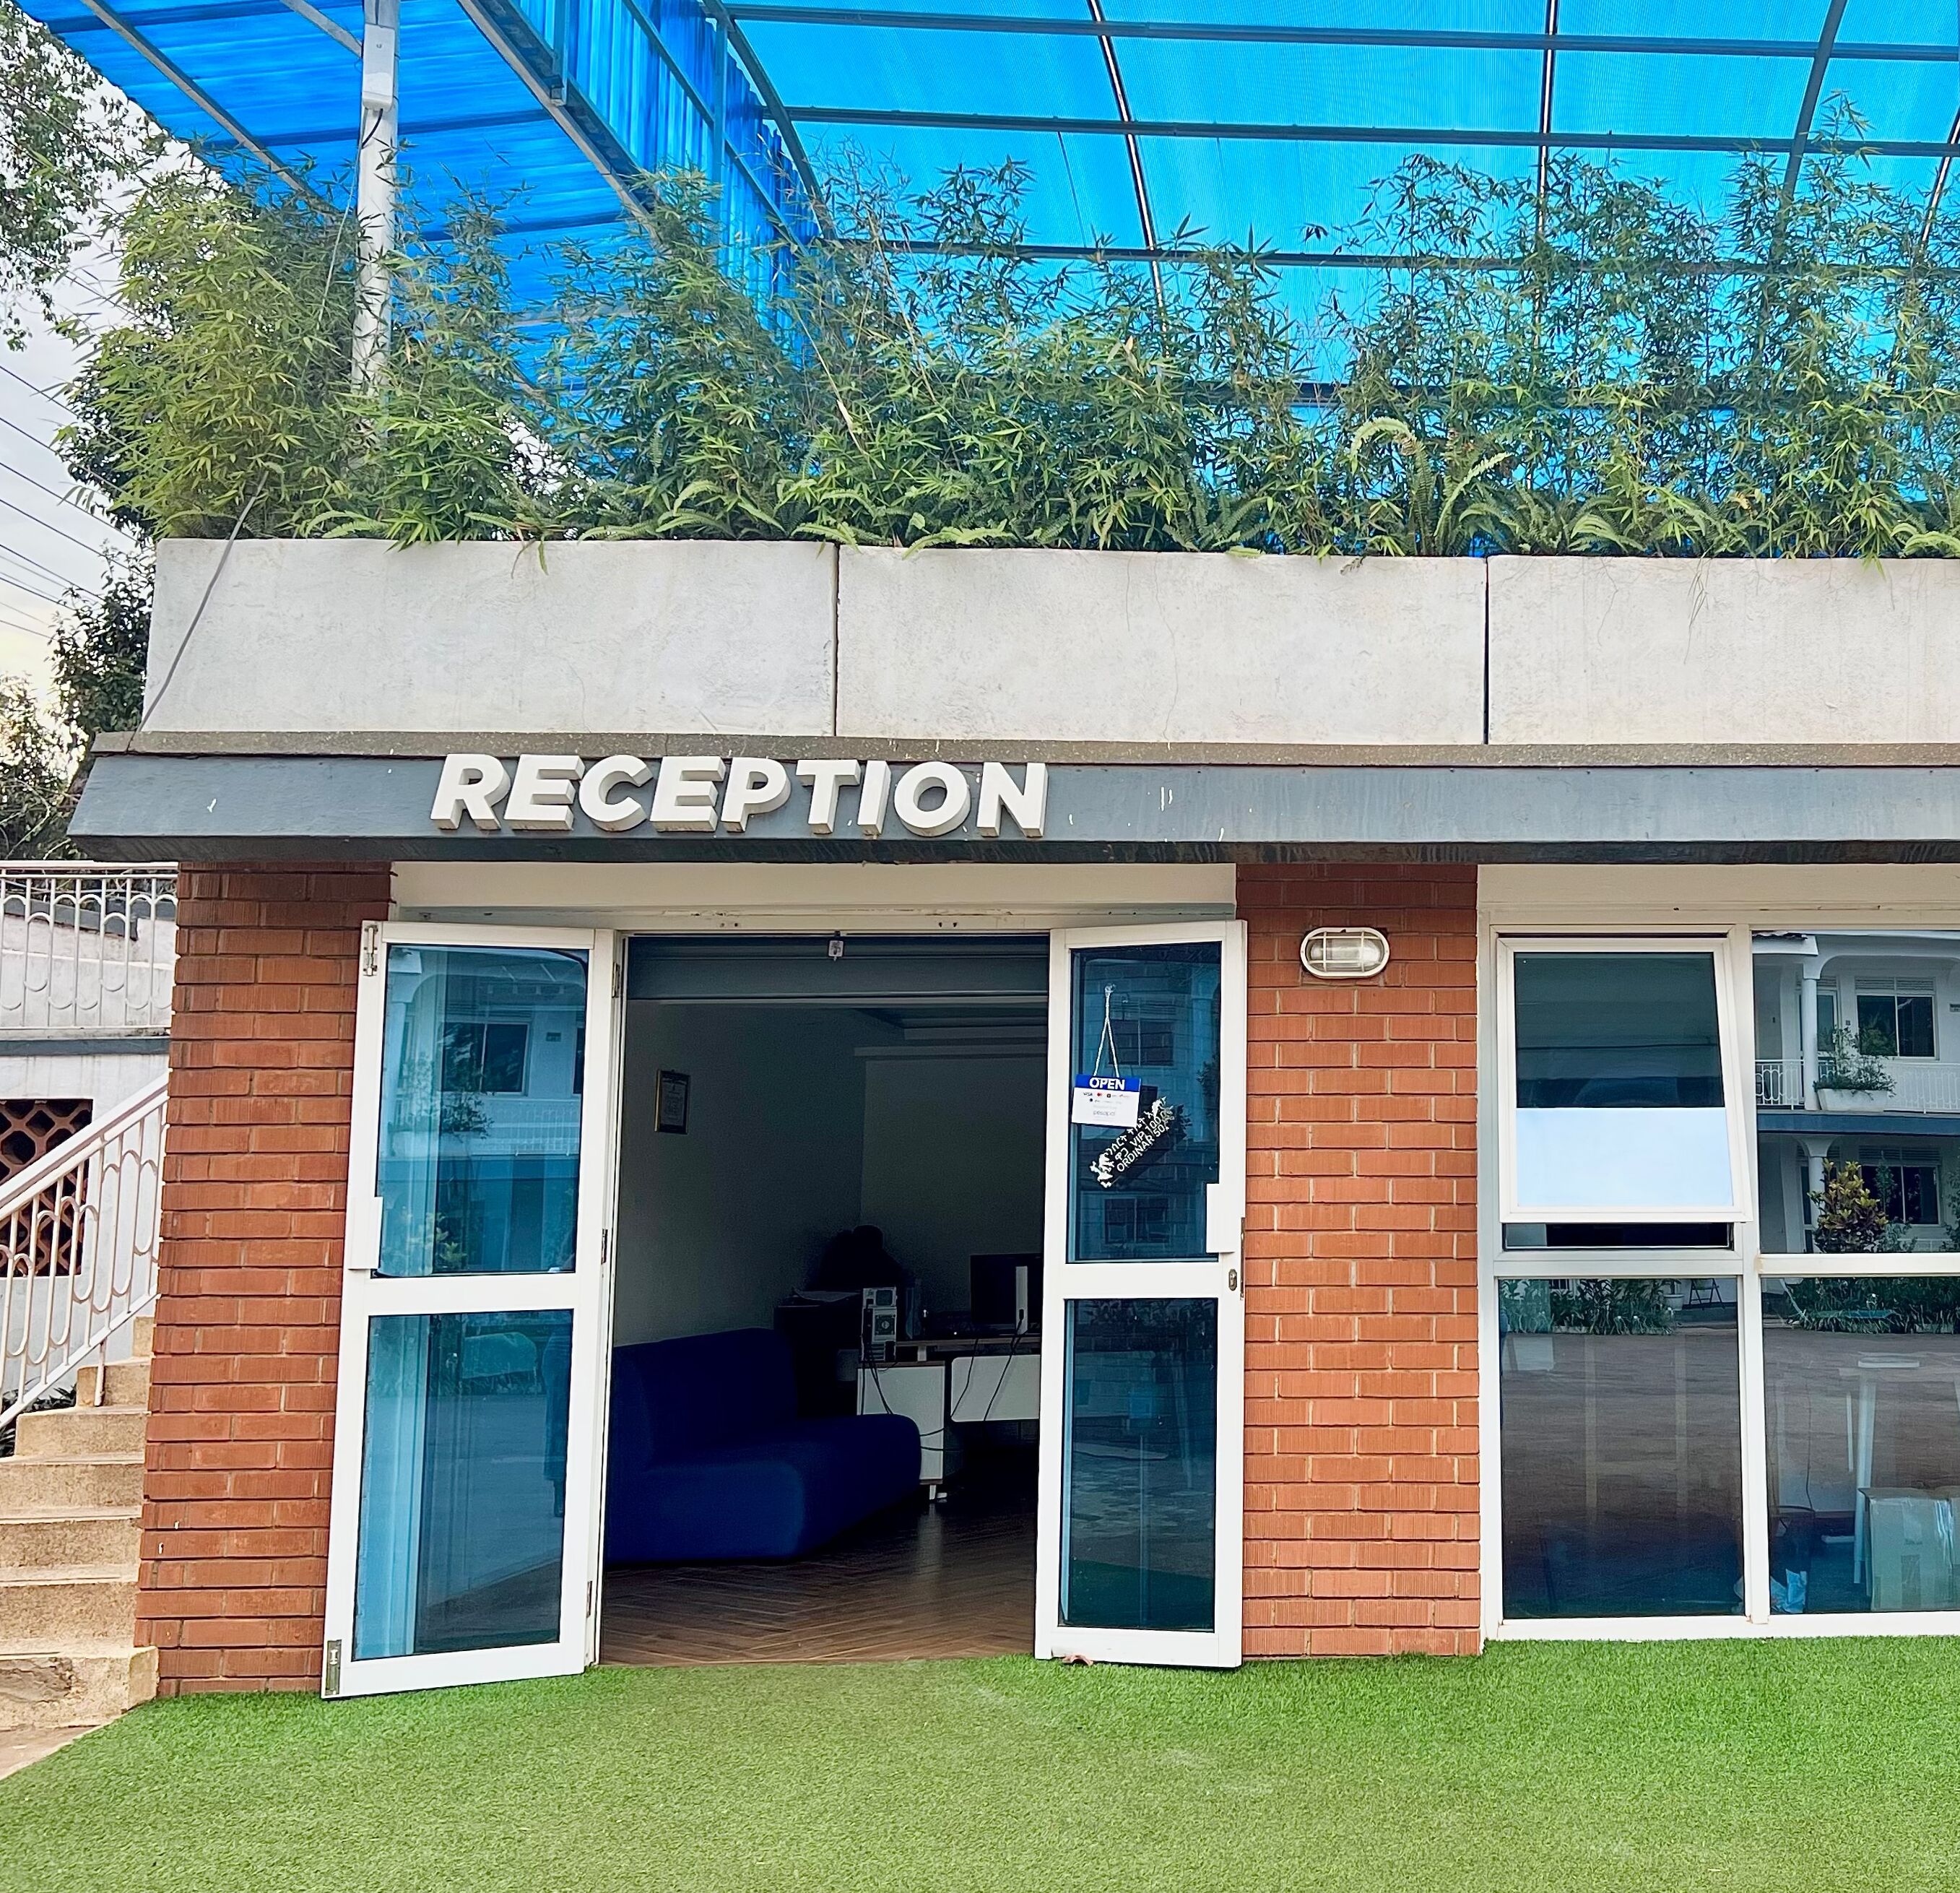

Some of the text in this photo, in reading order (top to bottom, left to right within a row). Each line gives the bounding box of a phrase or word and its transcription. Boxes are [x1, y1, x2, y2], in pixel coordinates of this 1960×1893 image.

[431, 753, 1049, 837] RECEPTION
[1089, 1077, 1125, 1090] OPEN
[1129, 1131, 1145, 1147] VIP
[1116, 1135, 1155, 1171] ORDINAR
